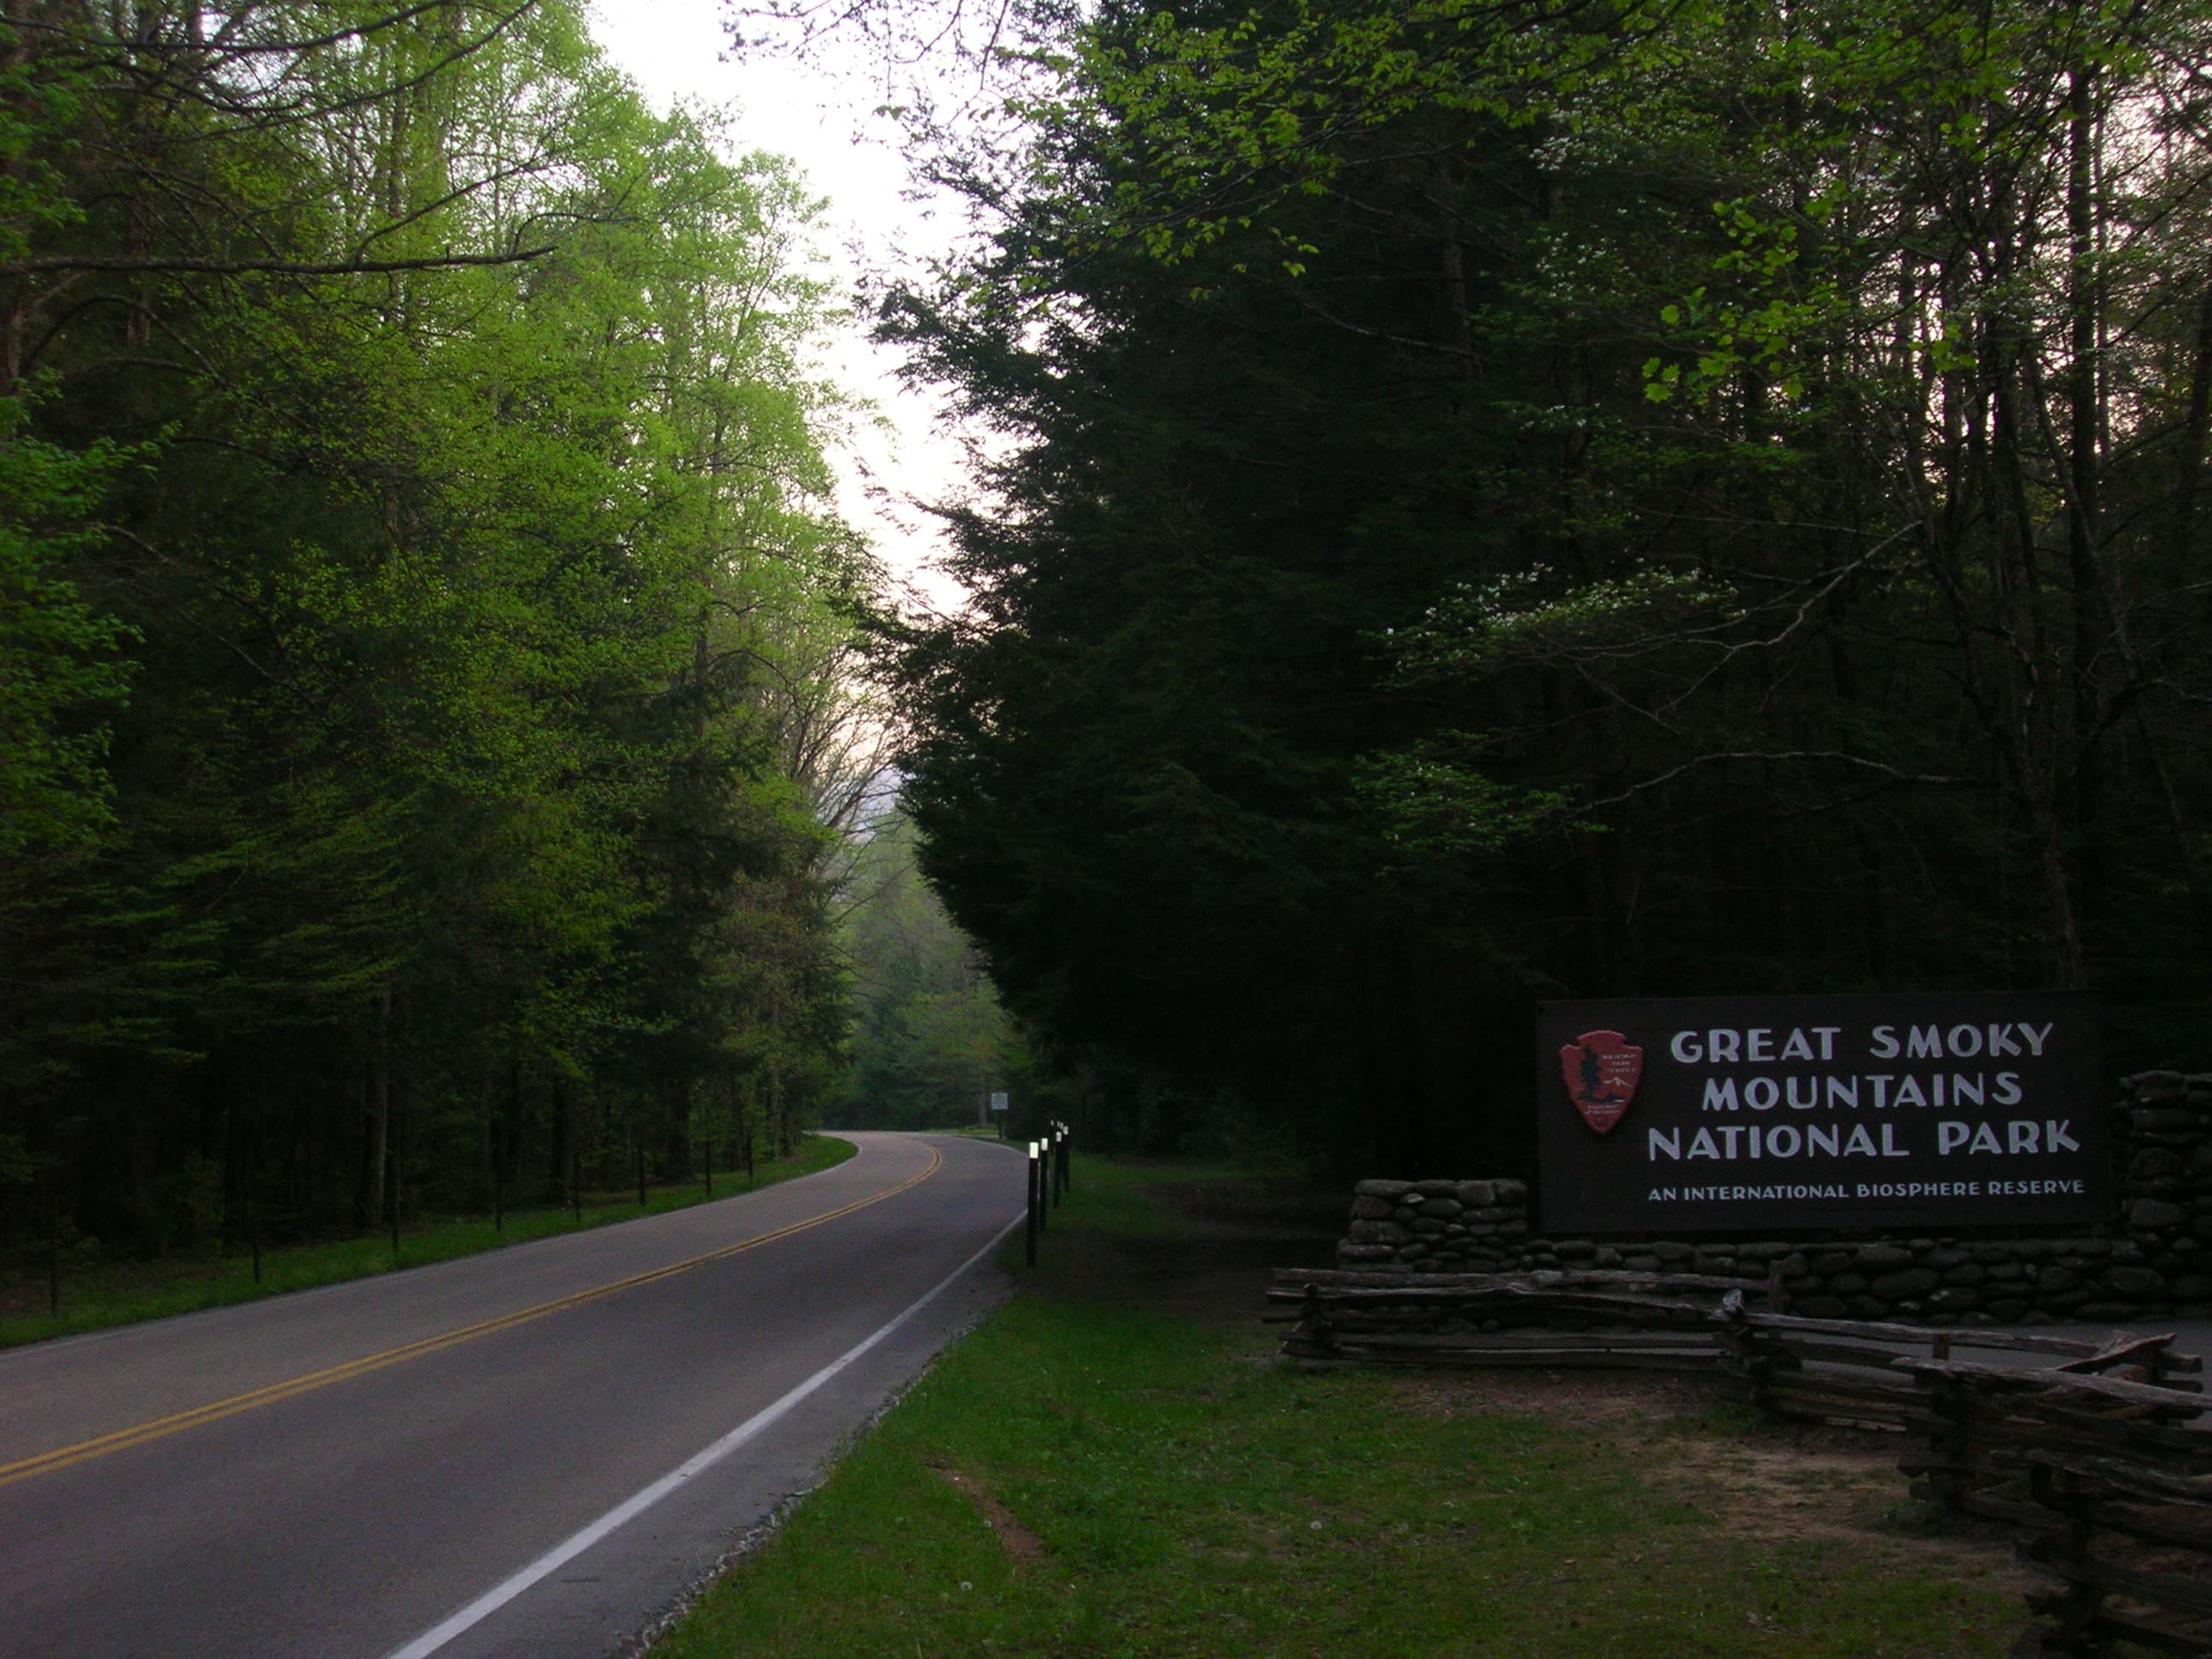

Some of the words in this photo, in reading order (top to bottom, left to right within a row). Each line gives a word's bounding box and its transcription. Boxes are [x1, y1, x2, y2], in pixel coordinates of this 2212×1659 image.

[1671, 1027, 1841, 1063] GREAT
[1870, 1022, 2053, 1059] SMOKY
[1703, 1072, 2023, 1111] MOUNTAINS
[1649, 1123, 1911, 1161] NATIONAL
[1938, 1120, 2080, 1155] PARK
[1649, 1187, 1676, 1201] AN
[1684, 1185, 1849, 1201] INTERNATIONAL
[1857, 1182, 1979, 1198] BIOSPHERE
[1988, 1179, 2085, 1195] RESERVE
